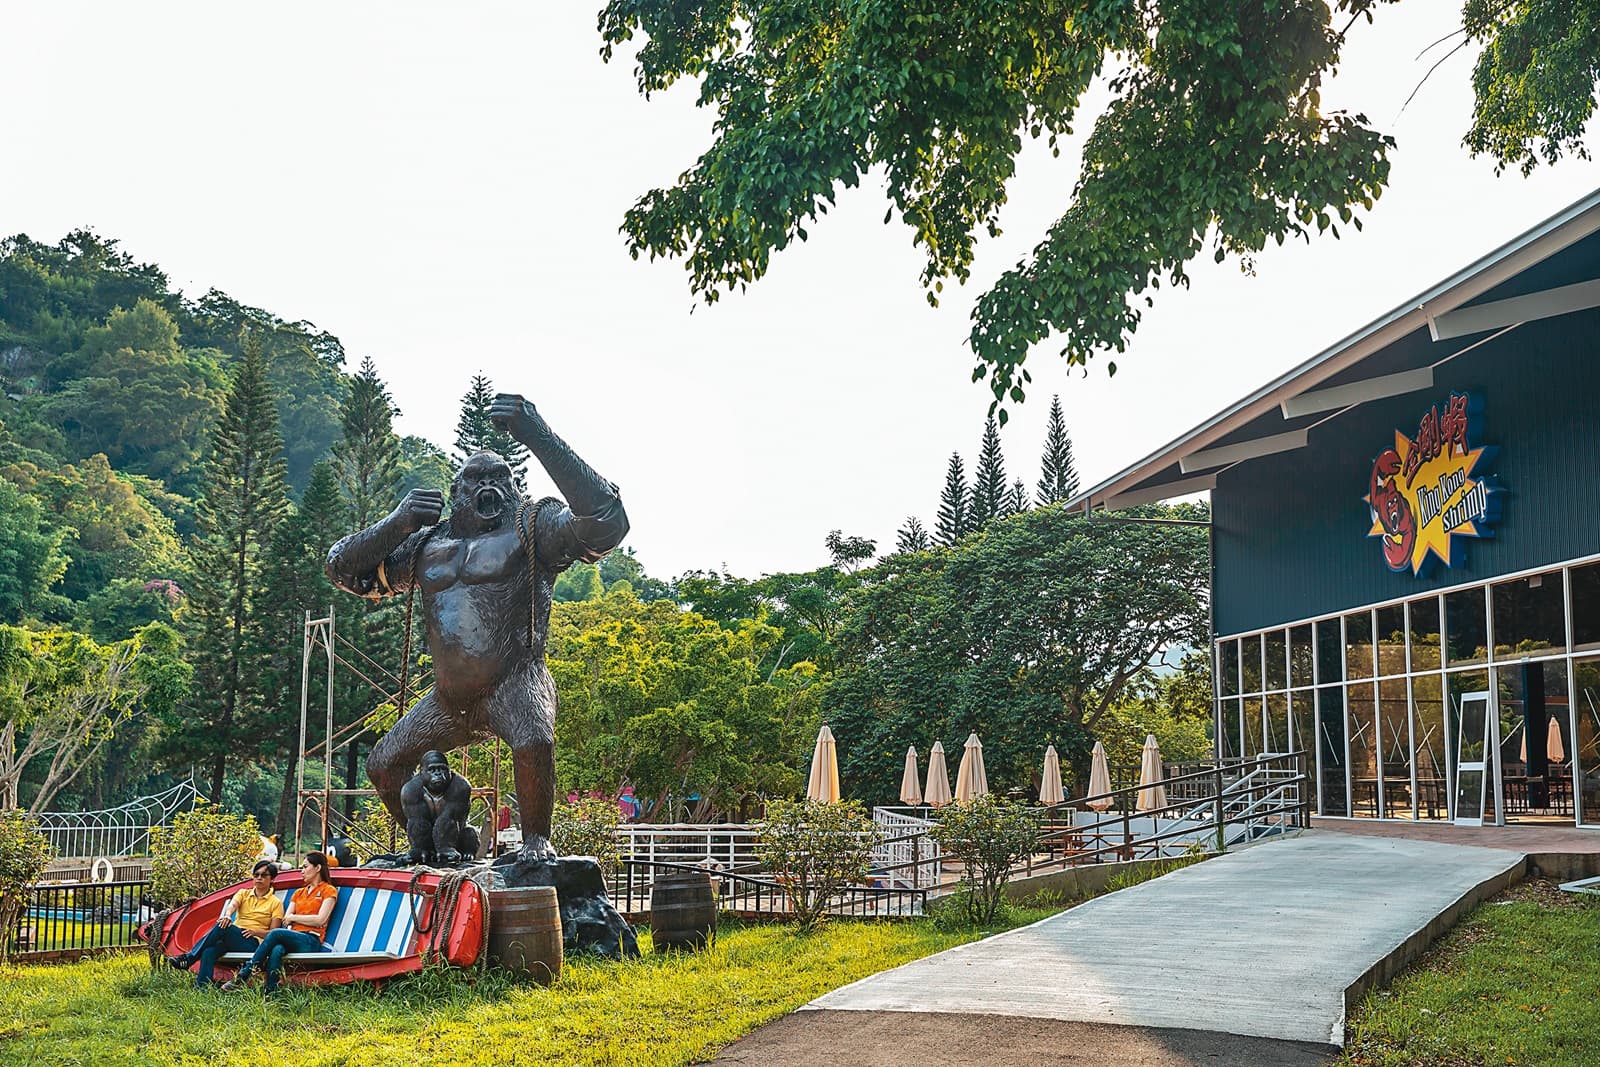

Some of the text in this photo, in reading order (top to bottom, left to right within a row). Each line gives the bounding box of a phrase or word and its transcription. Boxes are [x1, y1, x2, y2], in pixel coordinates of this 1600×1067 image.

[1417, 468, 1464, 528] King Kong
[1442, 479, 1486, 533] shrimp
